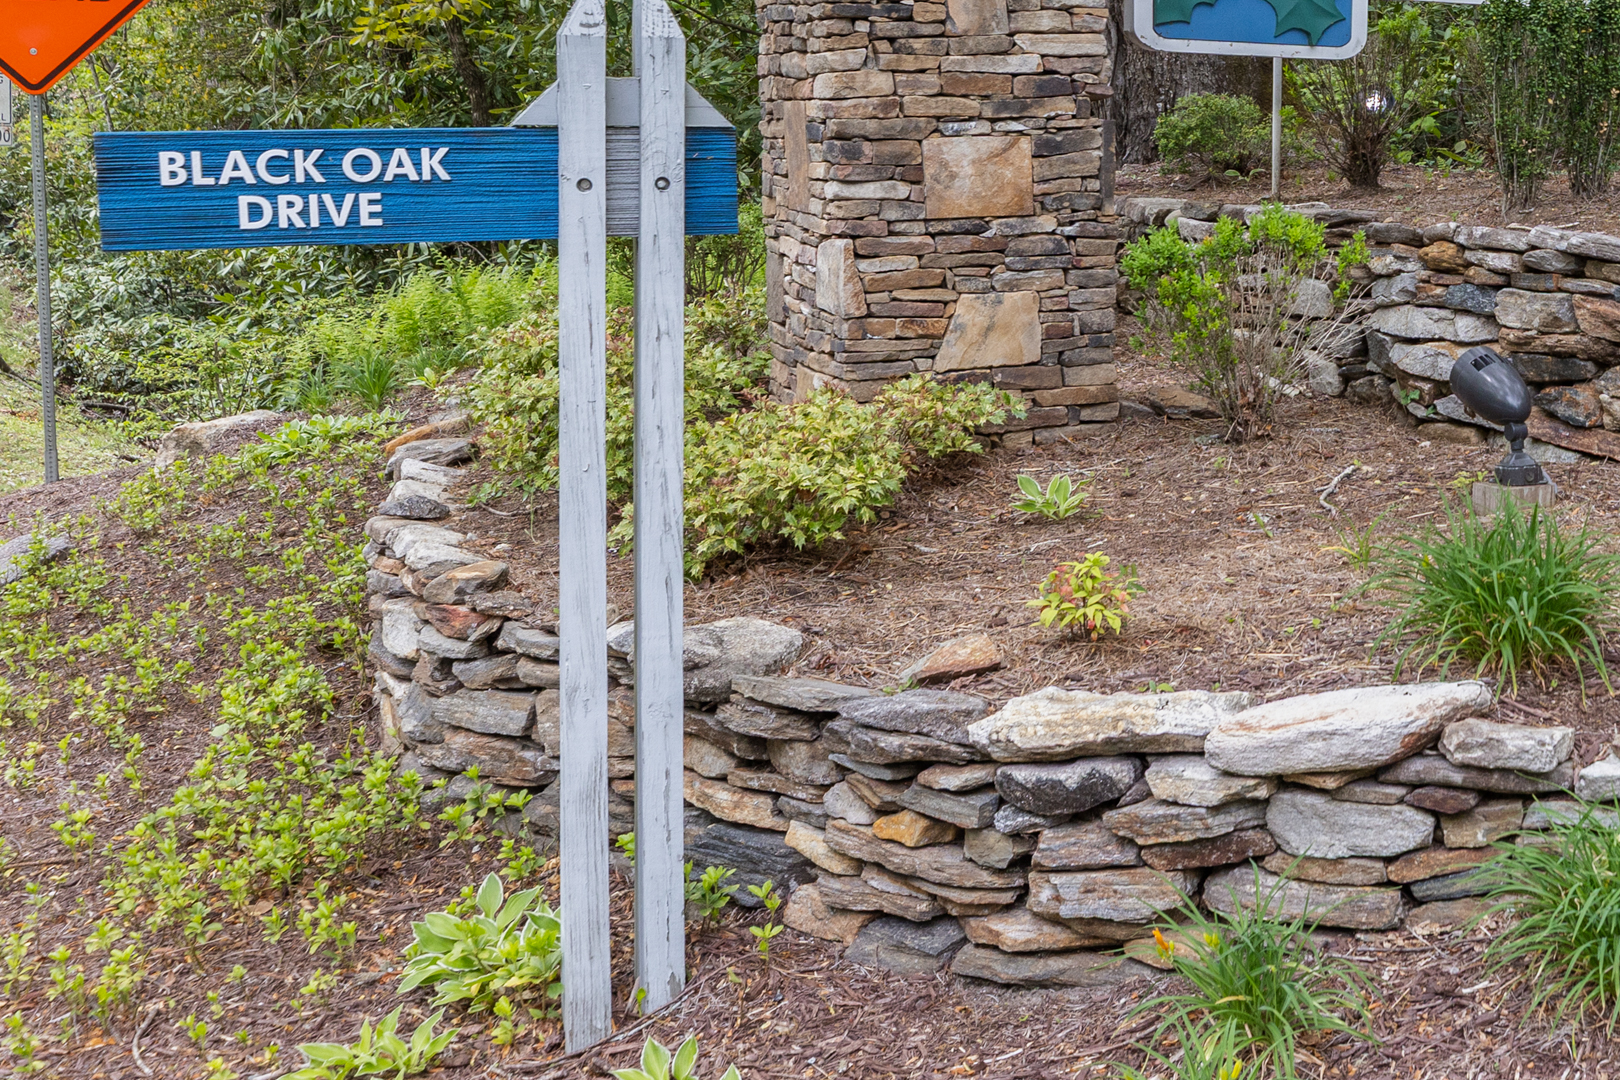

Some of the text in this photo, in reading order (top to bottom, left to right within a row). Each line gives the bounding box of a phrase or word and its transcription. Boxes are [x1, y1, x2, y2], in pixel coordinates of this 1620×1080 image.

[158, 147, 452, 186] BLACK OAK
[237, 192, 383, 230] DRIVE
